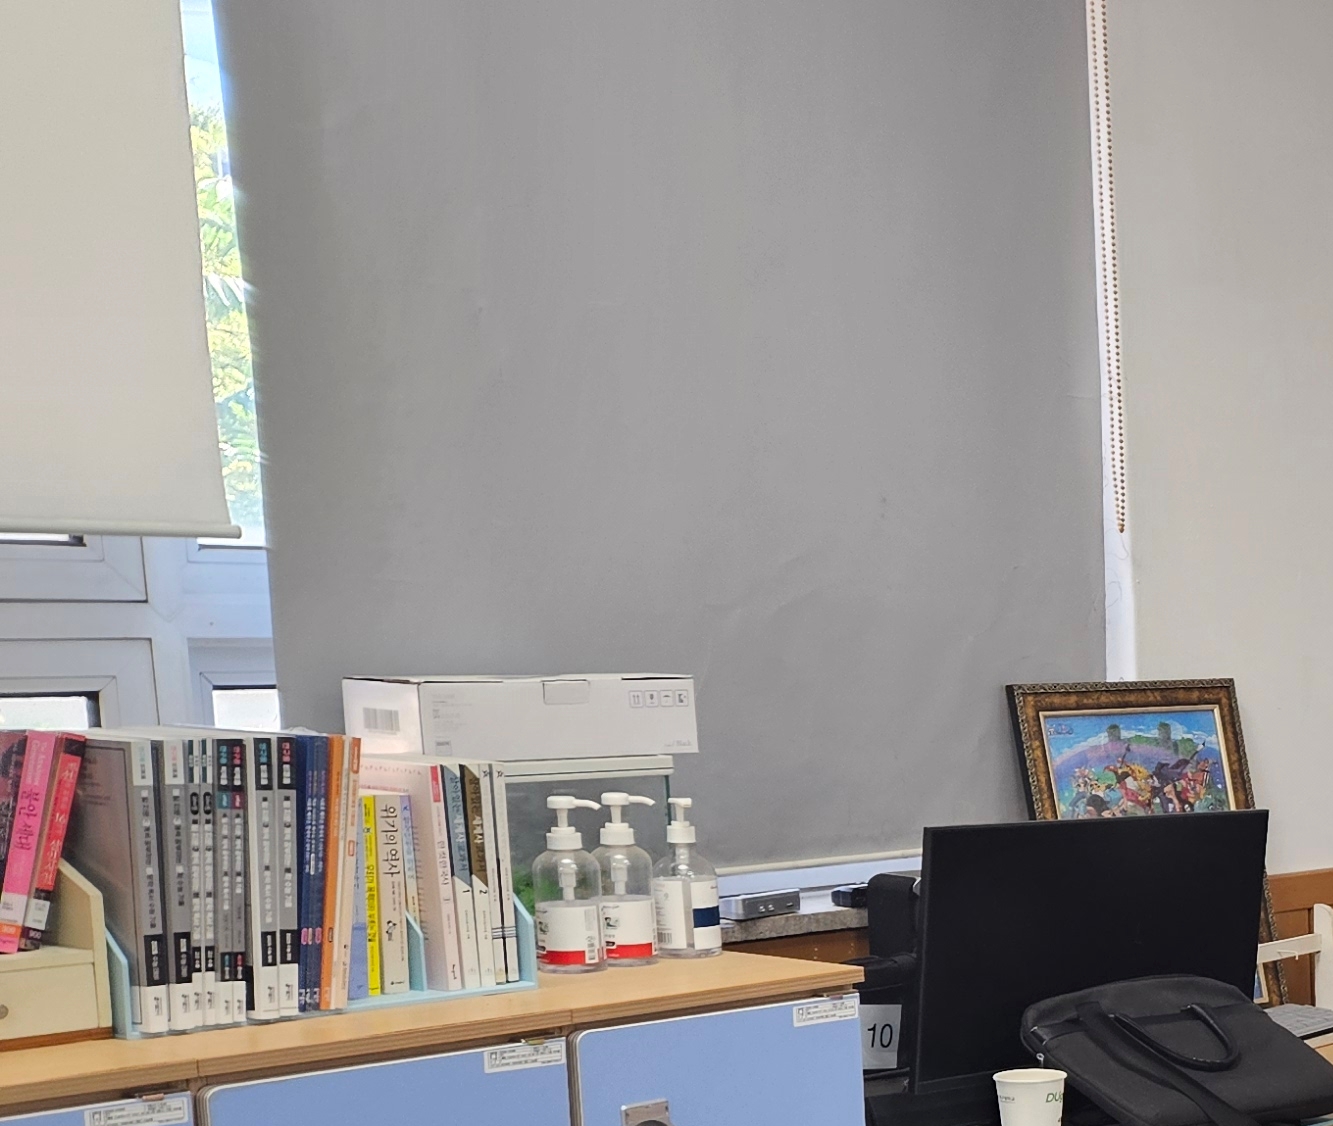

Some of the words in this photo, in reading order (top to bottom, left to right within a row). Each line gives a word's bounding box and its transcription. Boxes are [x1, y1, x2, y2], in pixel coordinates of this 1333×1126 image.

[19, 790, 41, 819] 불안
[15, 823, 35, 851] 세대
[380, 803, 398, 848] 위기의
[383, 848, 401, 878] 역사
[867, 1023, 894, 1048] 10
